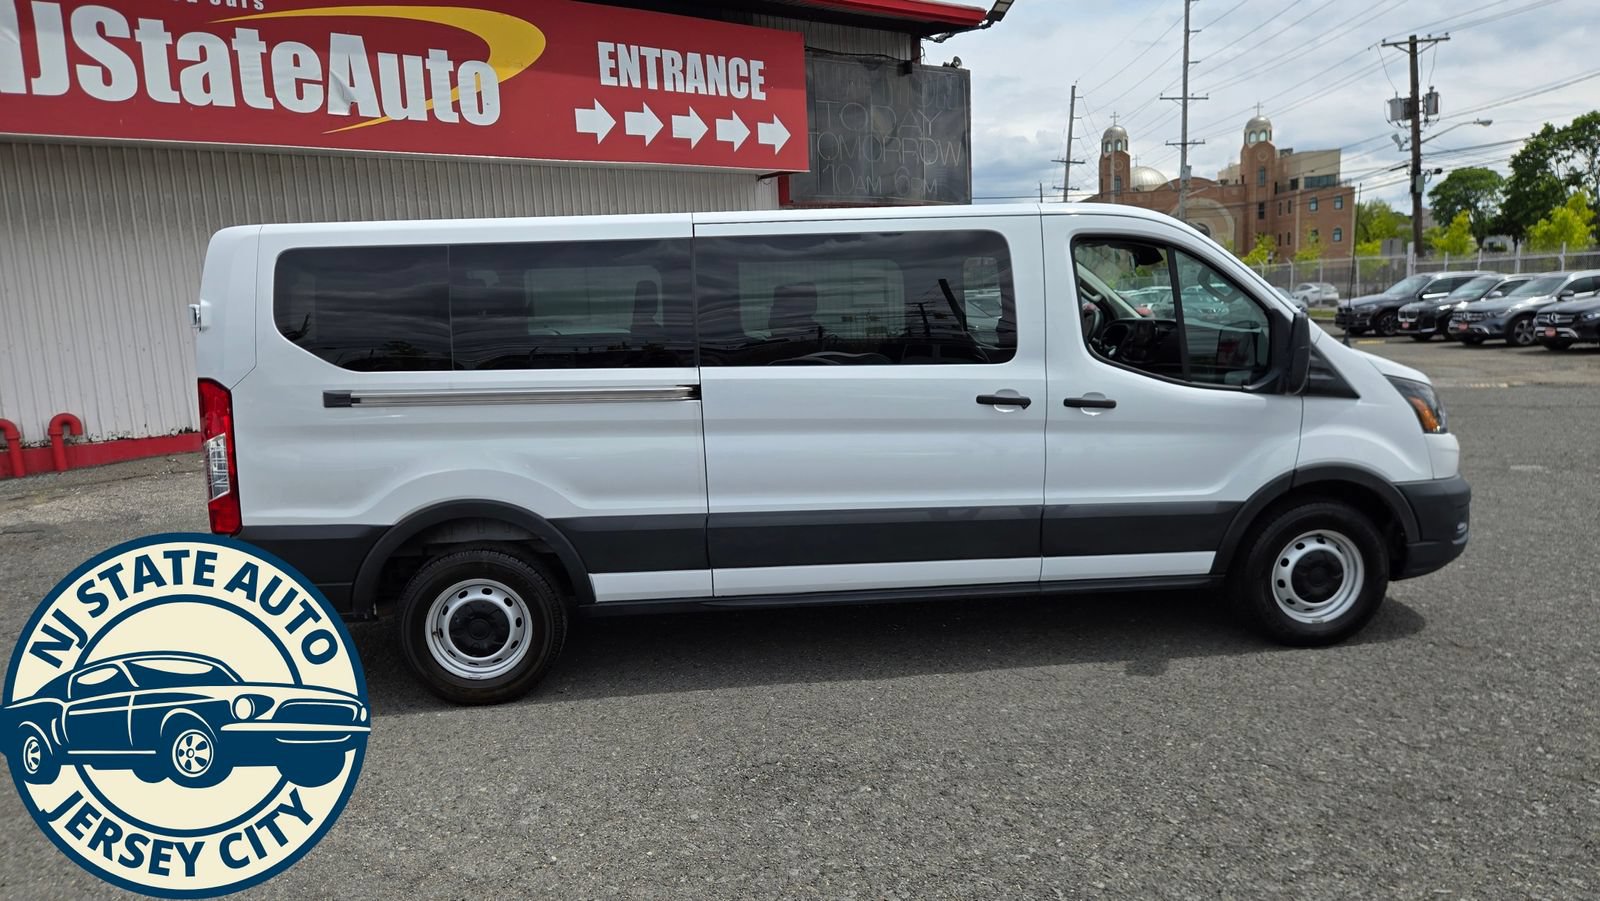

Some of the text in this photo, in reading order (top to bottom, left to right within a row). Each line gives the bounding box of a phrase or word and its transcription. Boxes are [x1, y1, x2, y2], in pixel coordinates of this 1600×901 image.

[597, 41, 766, 100] ENTRANCE
[815, 100, 943, 136] TODAY
[808, 132, 962, 167] TOMORROW
